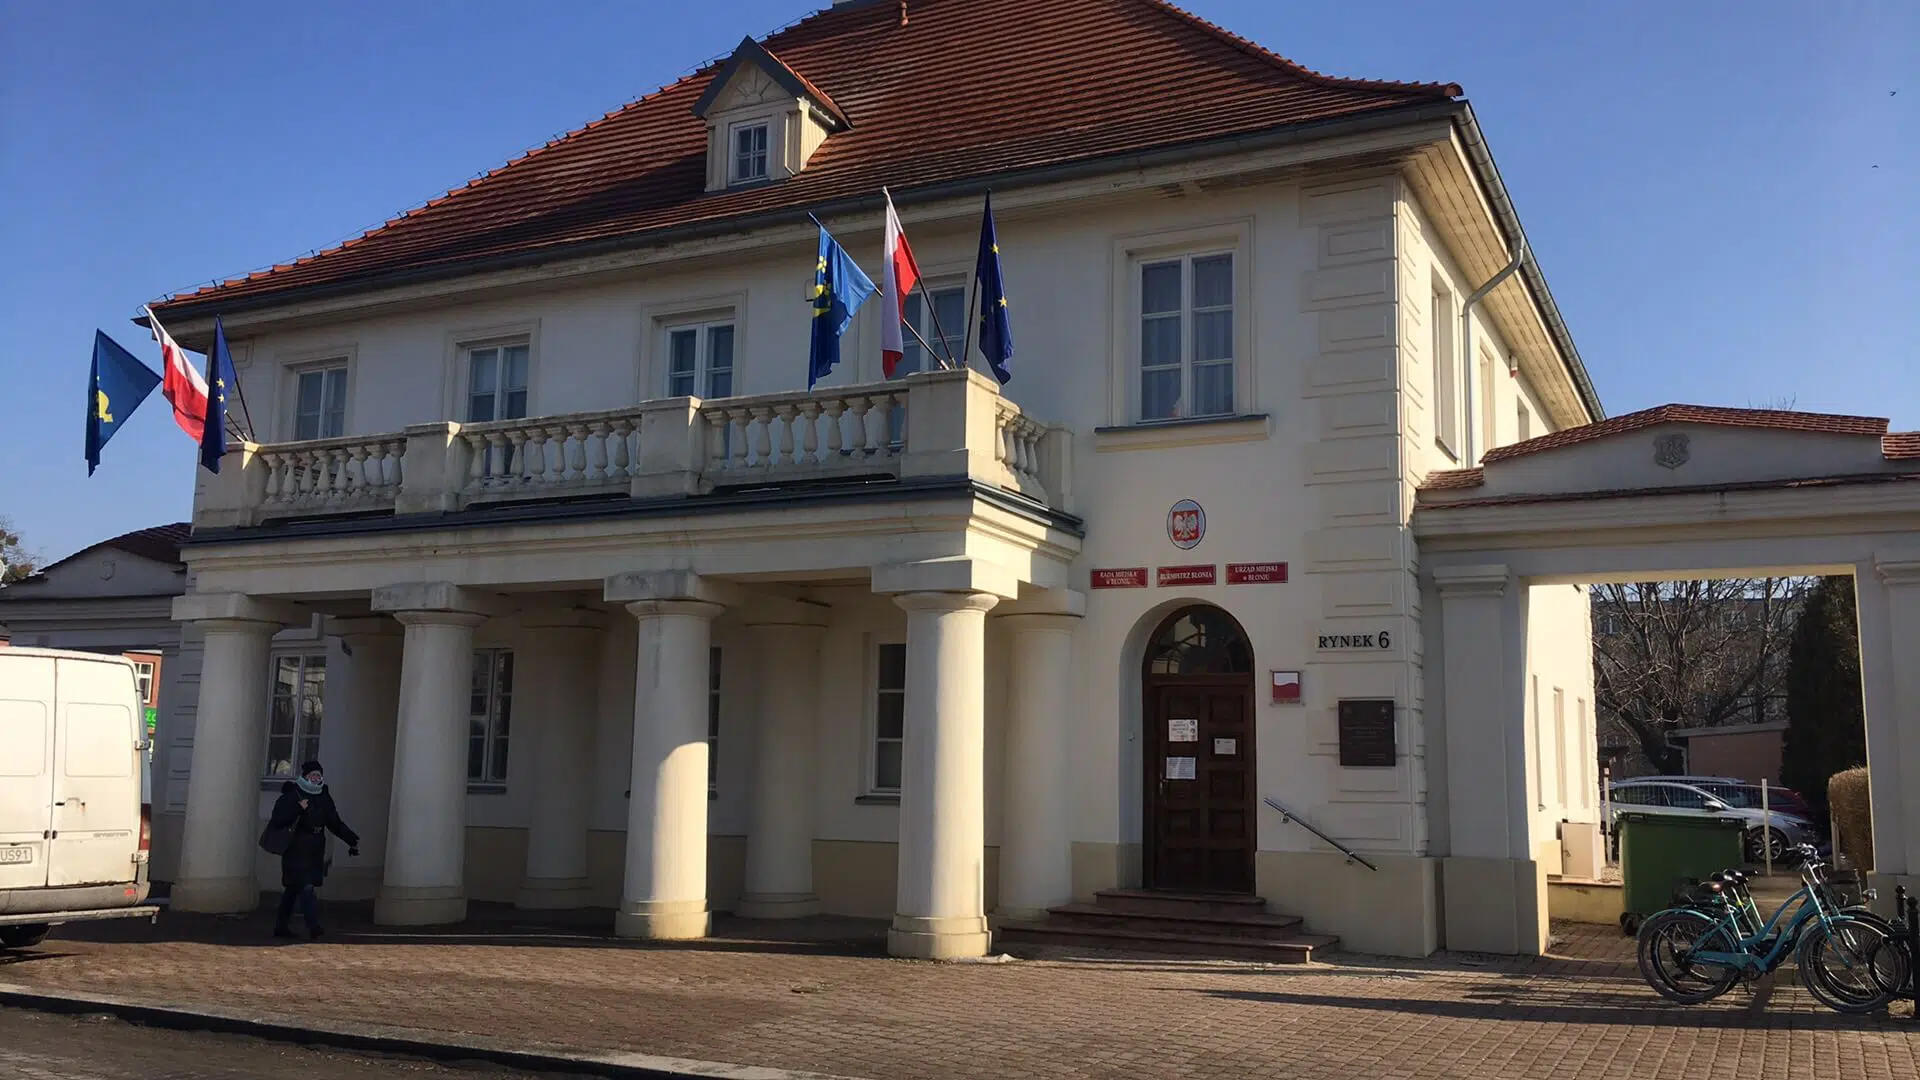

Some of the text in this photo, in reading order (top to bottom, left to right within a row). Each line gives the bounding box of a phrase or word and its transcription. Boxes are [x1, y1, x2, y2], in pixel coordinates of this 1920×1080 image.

[1159, 572, 1191, 580] BURMISTRZ
[1318, 631, 1389, 649] RYNEK 6
